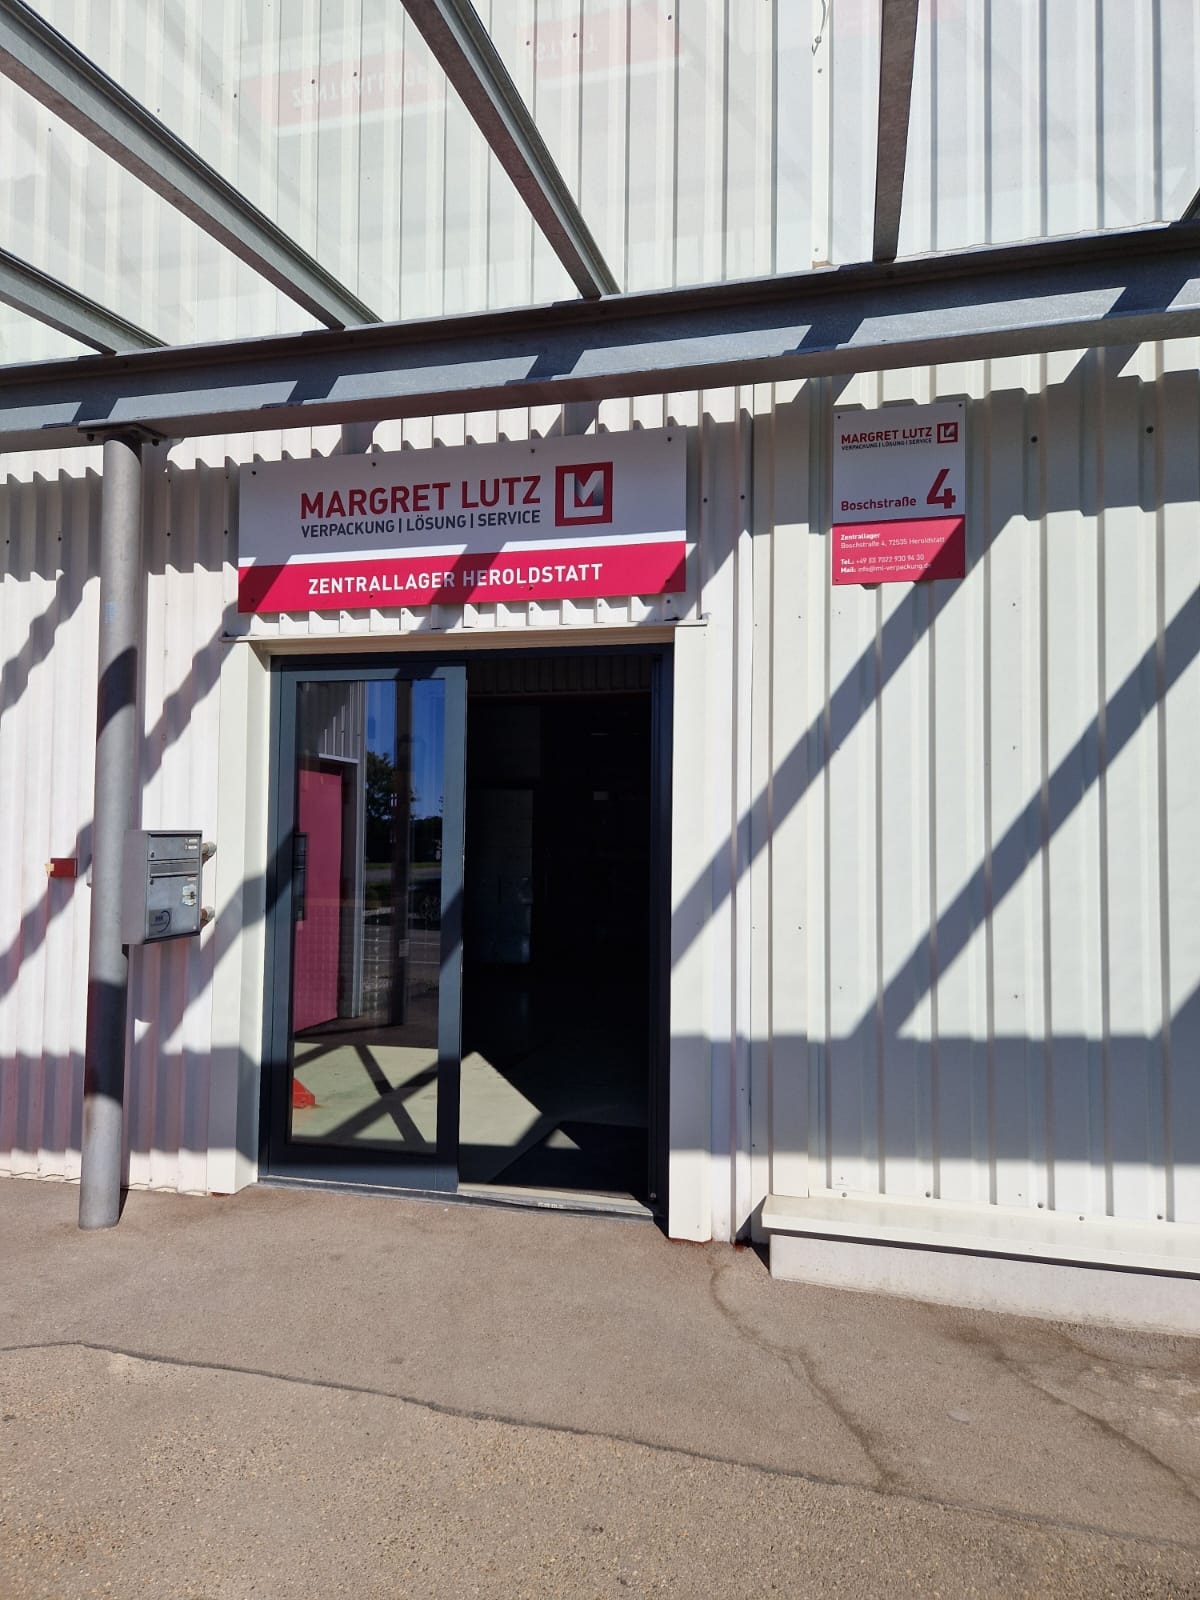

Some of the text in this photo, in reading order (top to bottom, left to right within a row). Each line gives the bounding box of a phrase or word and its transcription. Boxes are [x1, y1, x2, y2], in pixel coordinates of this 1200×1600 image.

[840, 426, 933, 445] MARGRET LUTZ
[841, 442, 878, 451] VERPACKUNG
[909, 438, 933, 446] SERVICE
[300, 475, 541, 520] MARGRET LUTZ
[841, 468, 957, 511] Boschstraße 4
[301, 519, 395, 538] VERPACKUNG
[406, 514, 467, 531] LÖSUNG
[477, 509, 541, 527] SERVICE
[840, 533, 880, 541] Zentrallager
[308, 563, 603, 595] ZENTRALLAGER HEROLDSTATT
